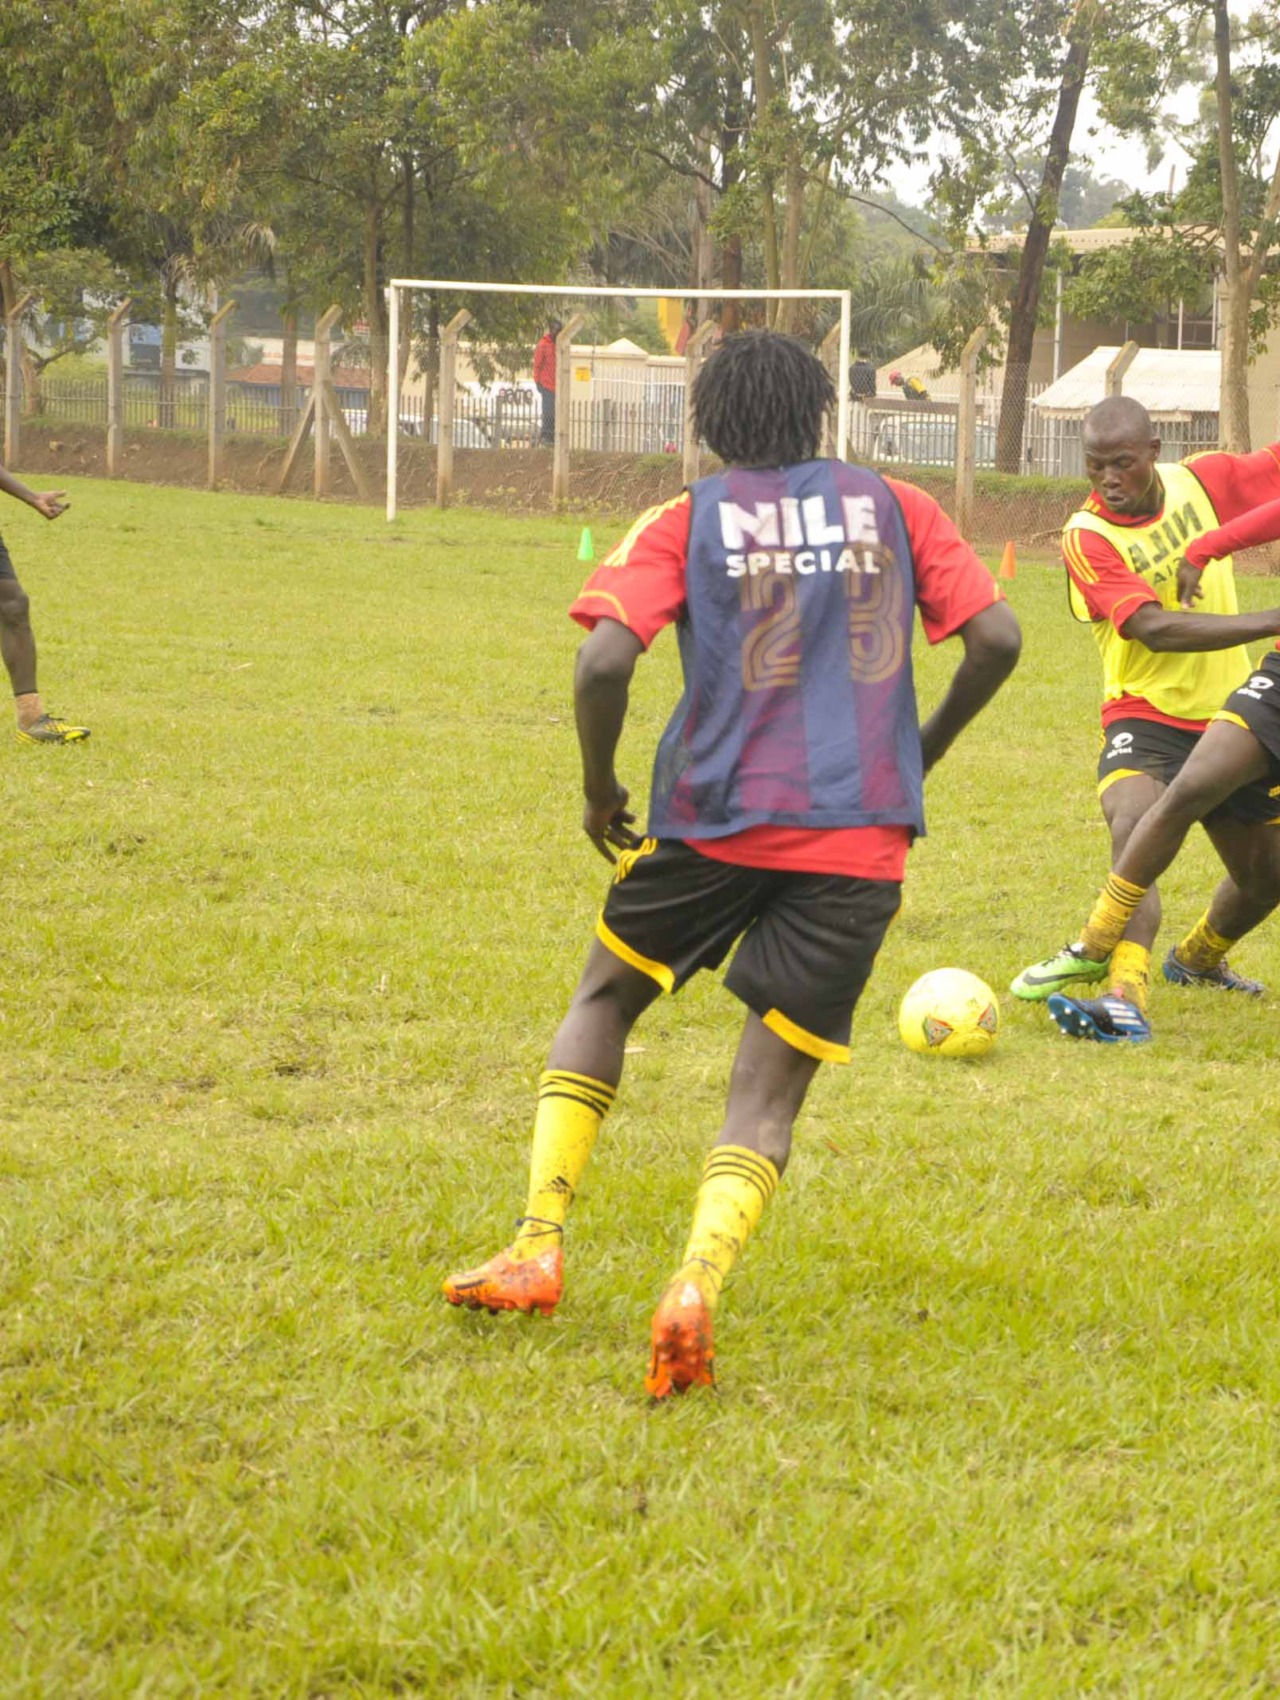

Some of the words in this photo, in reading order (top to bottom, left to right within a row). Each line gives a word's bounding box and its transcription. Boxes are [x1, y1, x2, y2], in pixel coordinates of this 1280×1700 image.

[717, 494, 881, 550] NILE
[725, 549, 882, 578] SPECIAL
[740, 541, 905, 692] 23
